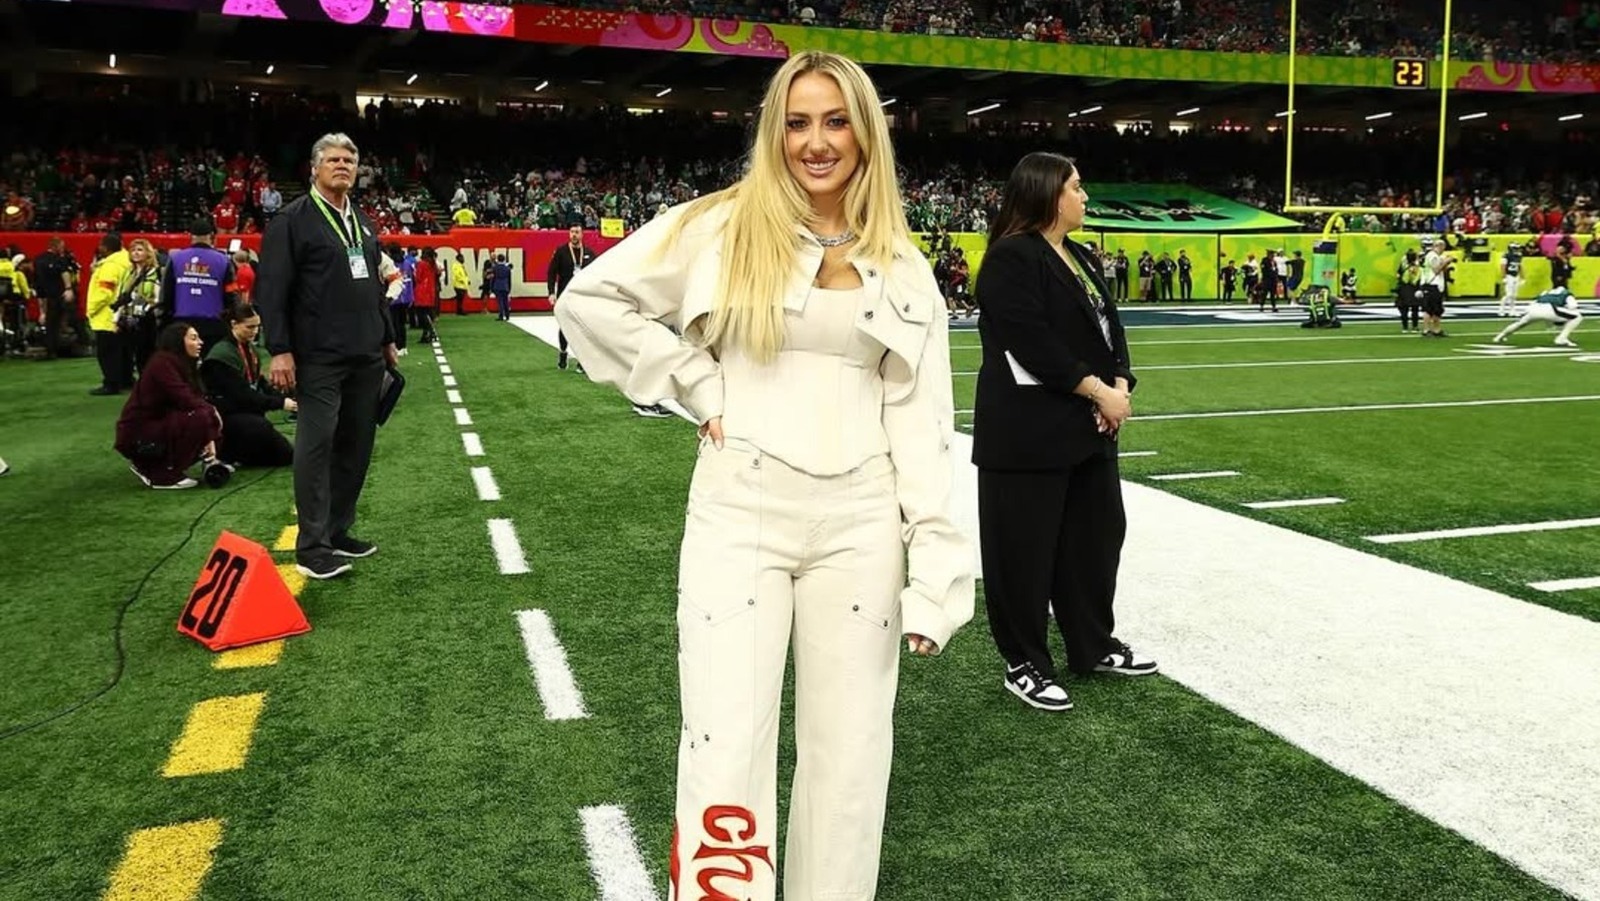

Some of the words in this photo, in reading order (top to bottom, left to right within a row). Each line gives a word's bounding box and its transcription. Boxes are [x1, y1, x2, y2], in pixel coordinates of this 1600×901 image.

[1396, 61, 1423, 85] 23
[401, 247, 549, 299] OWL
[181, 548, 248, 639] 20
[692, 805, 775, 901] ch
